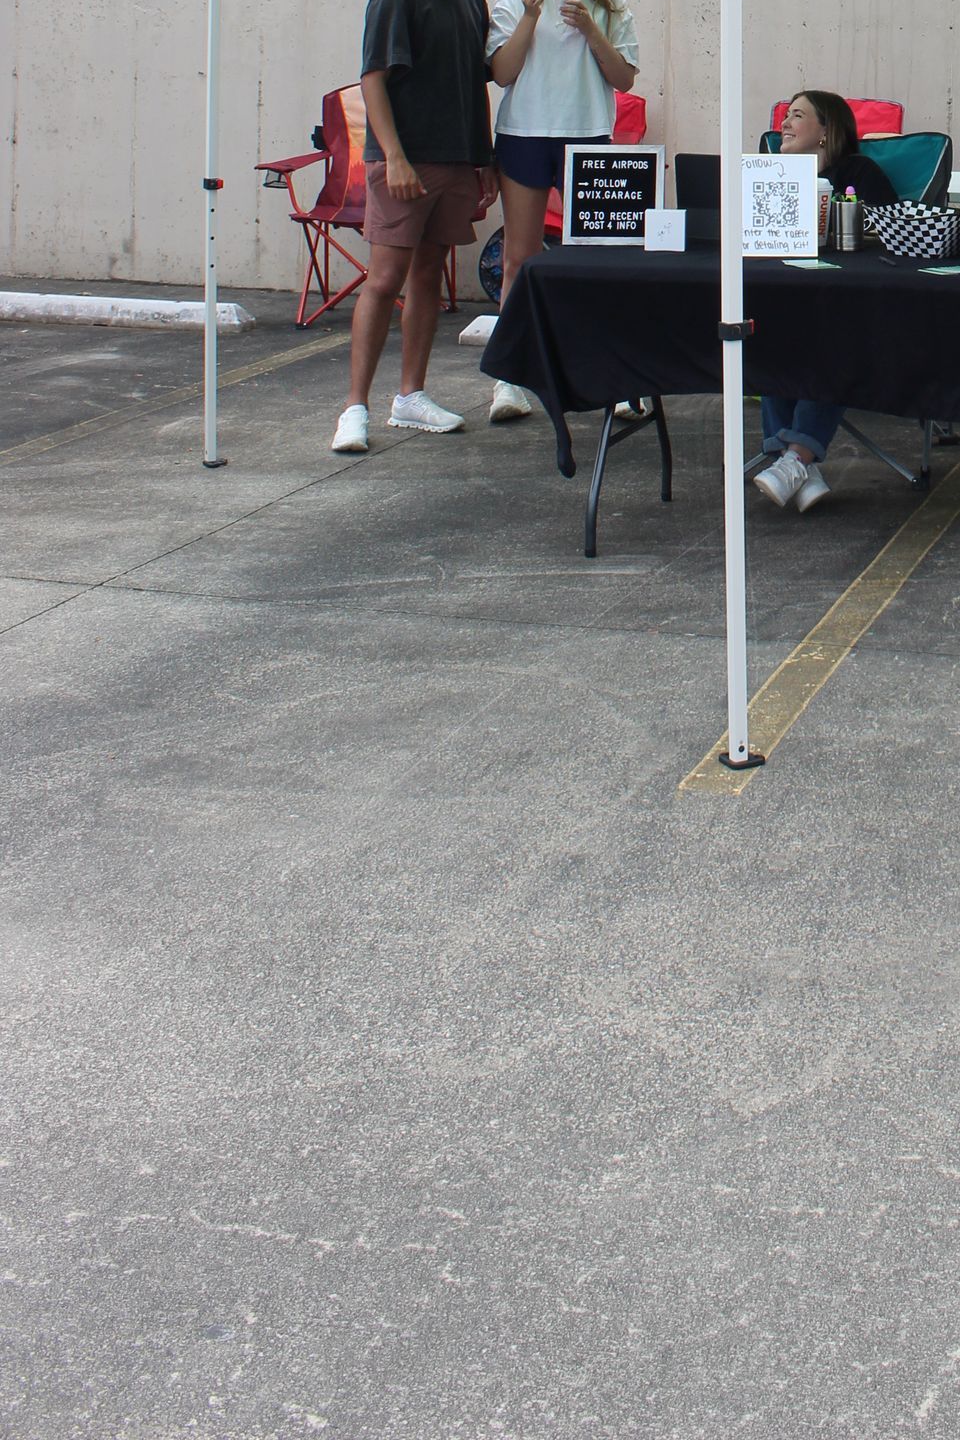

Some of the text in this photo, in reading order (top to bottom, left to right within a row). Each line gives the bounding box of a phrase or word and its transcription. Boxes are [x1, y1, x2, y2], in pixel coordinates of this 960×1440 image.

[582, 160, 649, 170] FREE AIRPODS
[593, 179, 627, 188] FOLLOW
[577, 191, 643, 200] @VIX.GARAGE
[579, 211, 644, 220] GO TO RECENT
[583, 221, 637, 230] POST 4 INFO
[744, 229, 763, 237] nter
